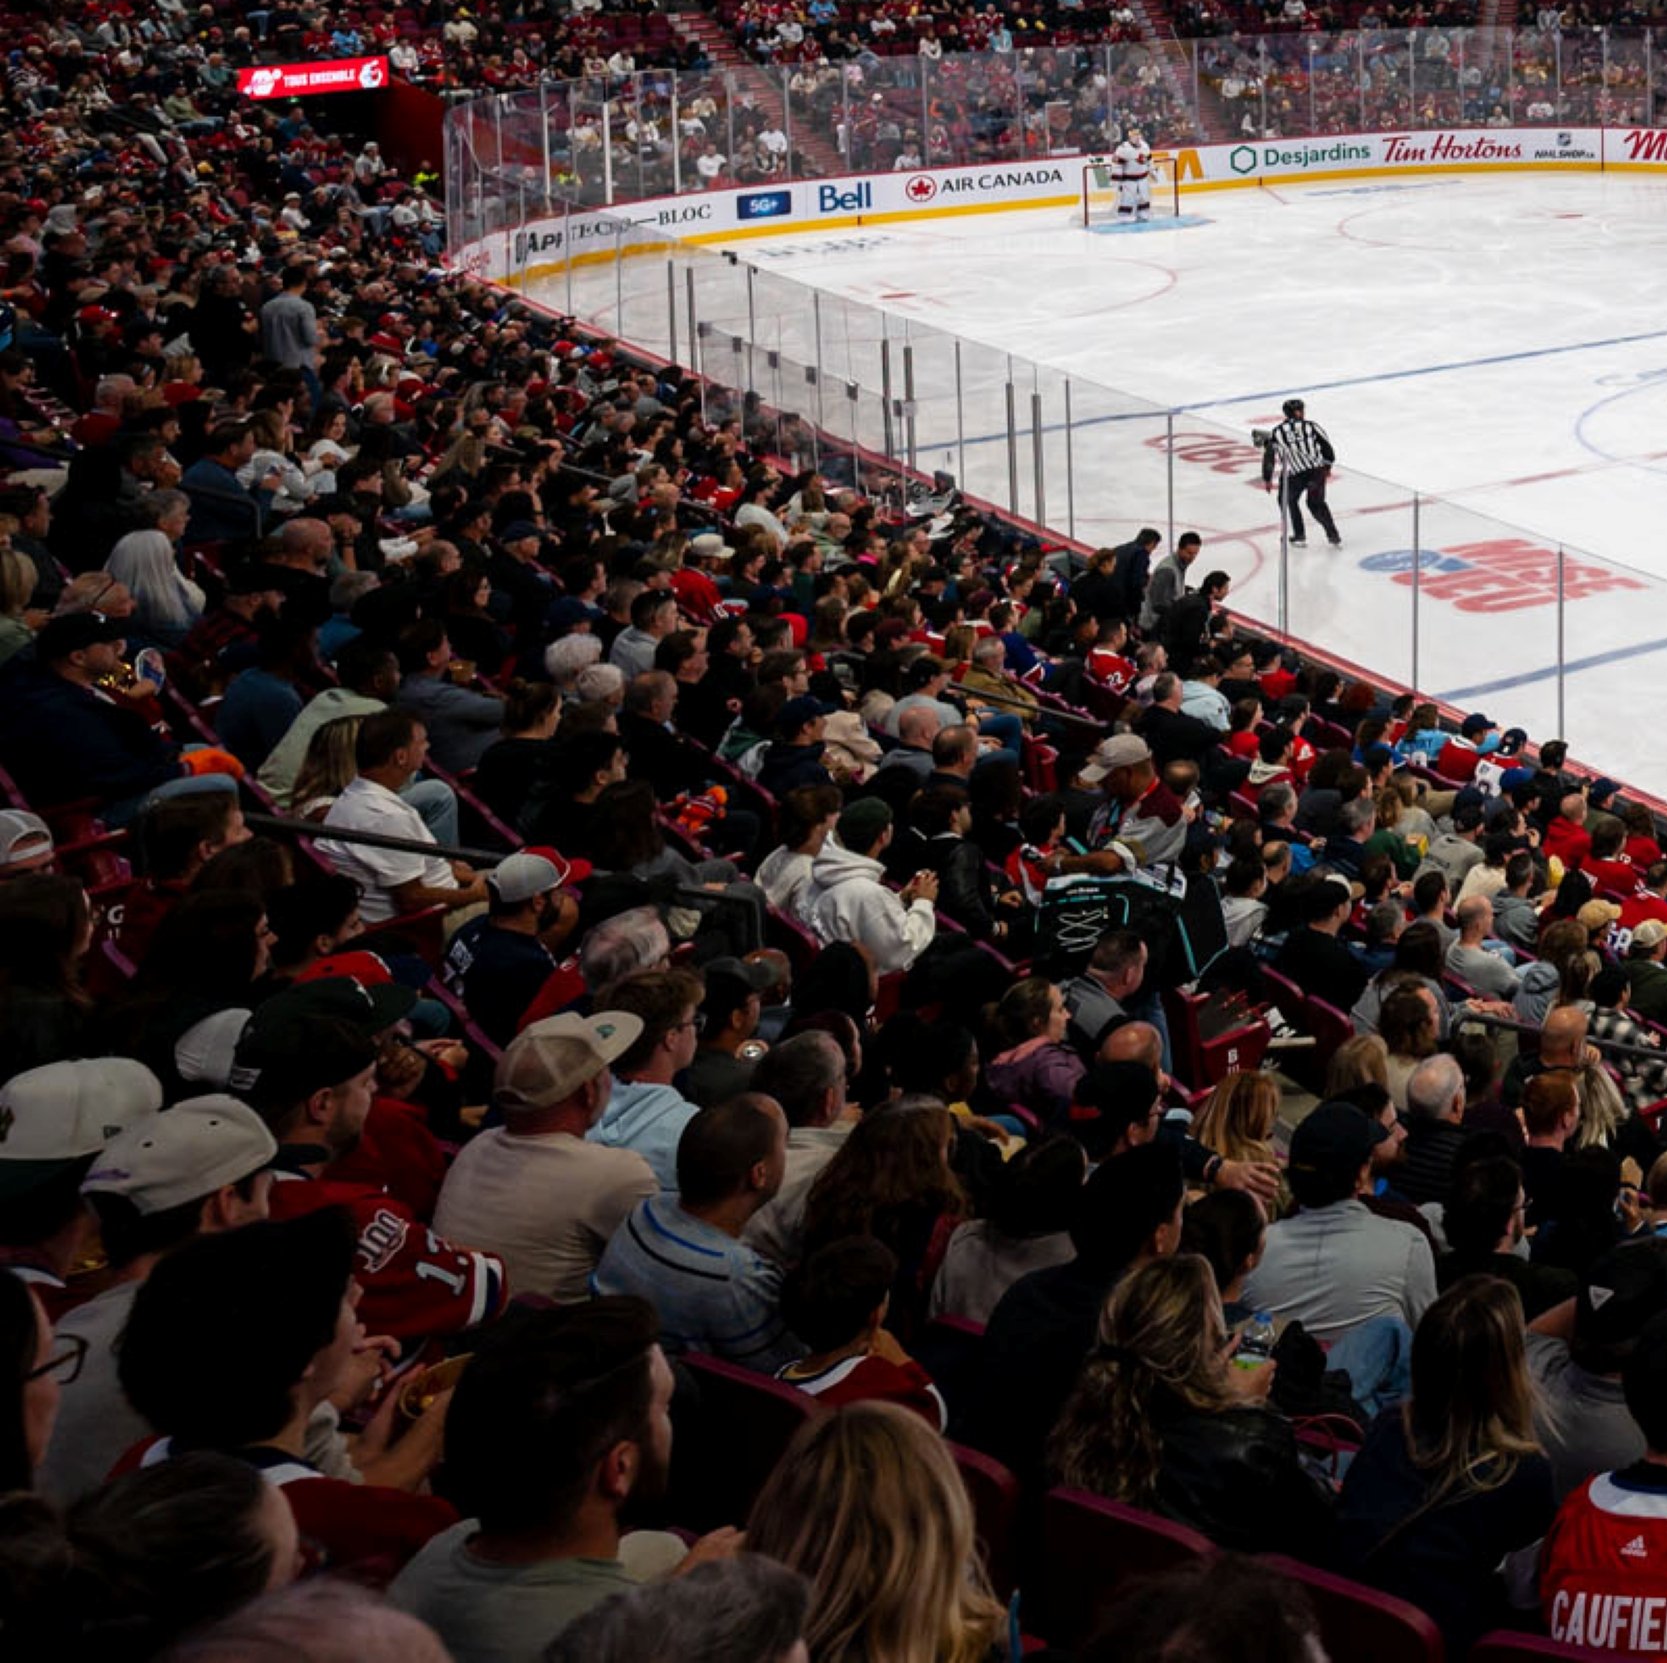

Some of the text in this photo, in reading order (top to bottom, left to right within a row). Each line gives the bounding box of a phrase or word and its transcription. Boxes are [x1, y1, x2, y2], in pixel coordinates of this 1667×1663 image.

[309, 70, 355, 85] ENSEMBLE
[1265, 142, 1371, 168] Desjardins
[1383, 133, 1521, 162] Tim Hortons
[941, 168, 1063, 194] AIR CANADA
[750, 197, 779, 214] 5G+
[819, 182, 871, 213] Bell
